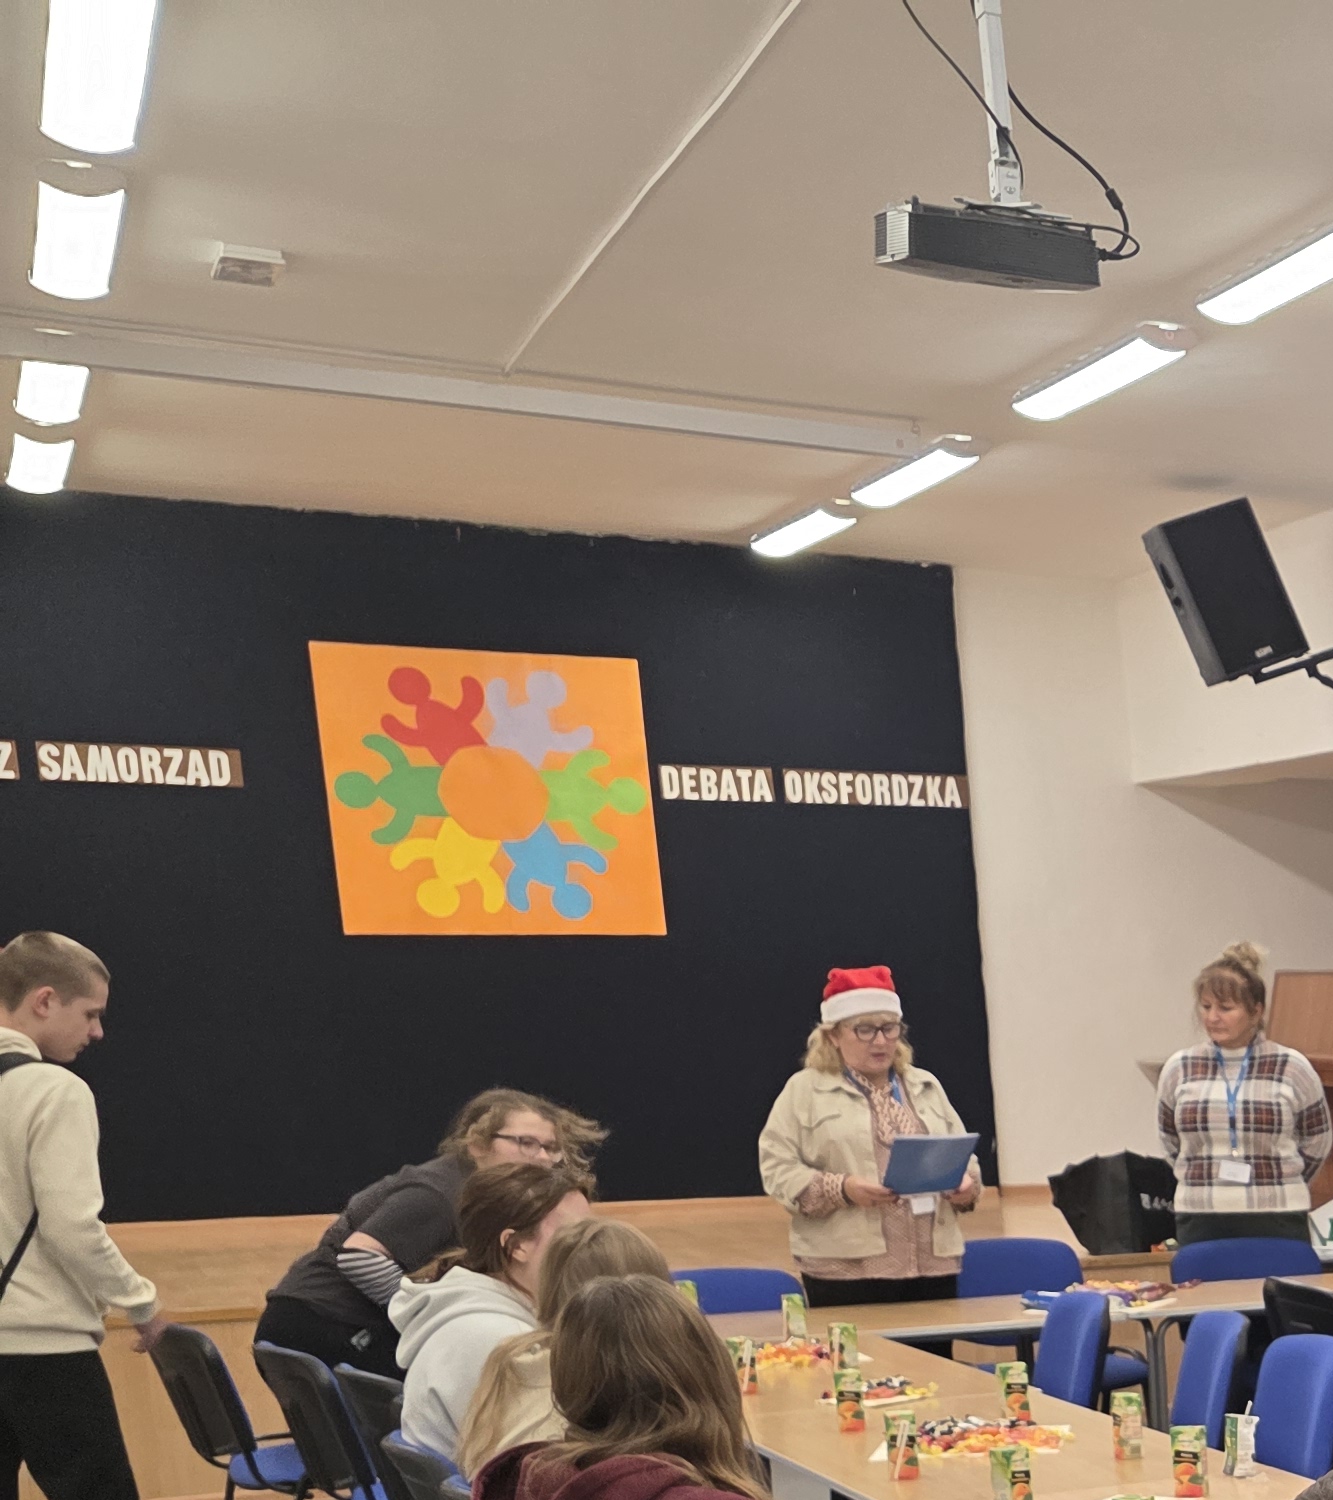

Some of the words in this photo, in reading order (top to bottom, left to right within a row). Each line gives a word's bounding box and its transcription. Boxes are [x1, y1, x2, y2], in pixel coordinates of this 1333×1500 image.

[38, 743, 231, 787] SAMORZAD
[660, 765, 773, 802] DEBATA
[784, 770, 962, 808] OKSFORDZKA
